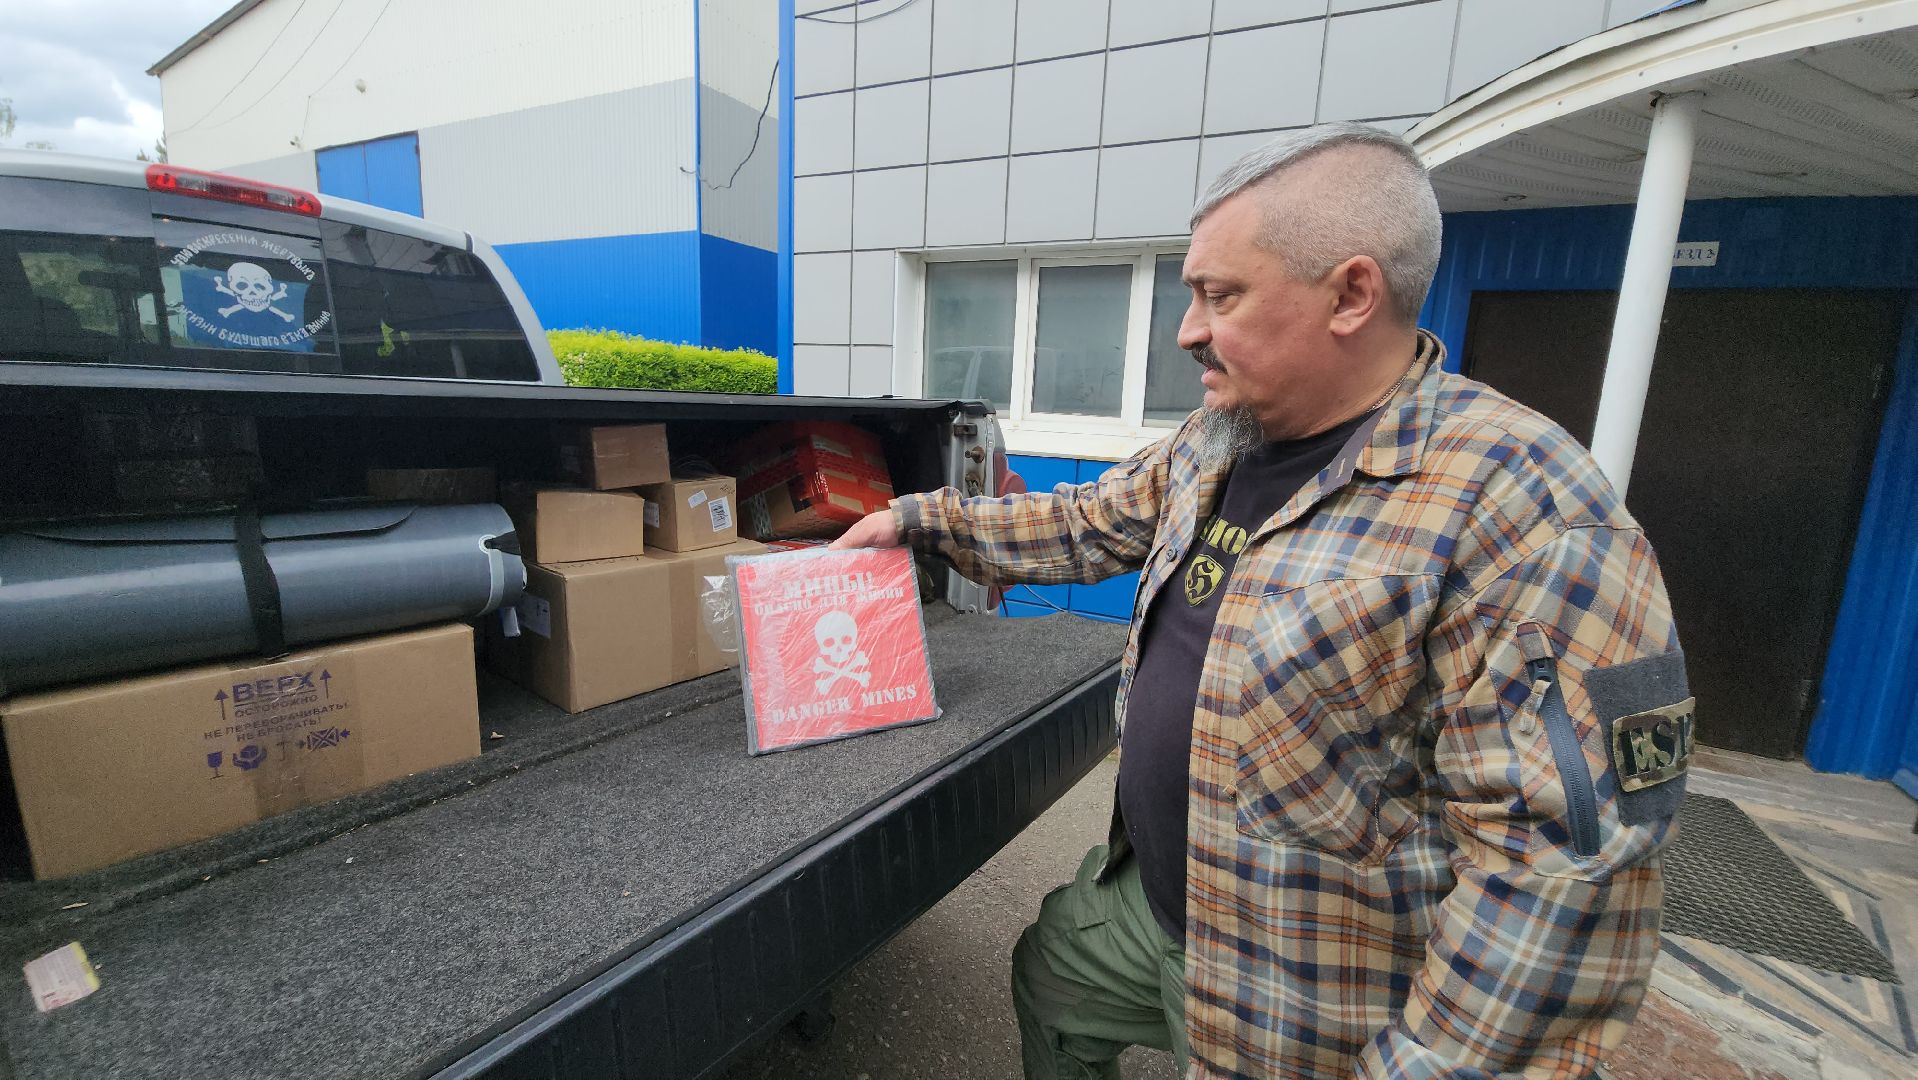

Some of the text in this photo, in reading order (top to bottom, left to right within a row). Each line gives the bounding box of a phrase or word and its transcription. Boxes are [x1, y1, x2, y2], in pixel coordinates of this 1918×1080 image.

[1673, 248, 1702, 260] ЕЗД
[232, 671, 315, 704] ВЕРХ
[235, 694, 319, 718] ОСТОРОЖНО
[772, 684, 917, 723] DANGER MINES
